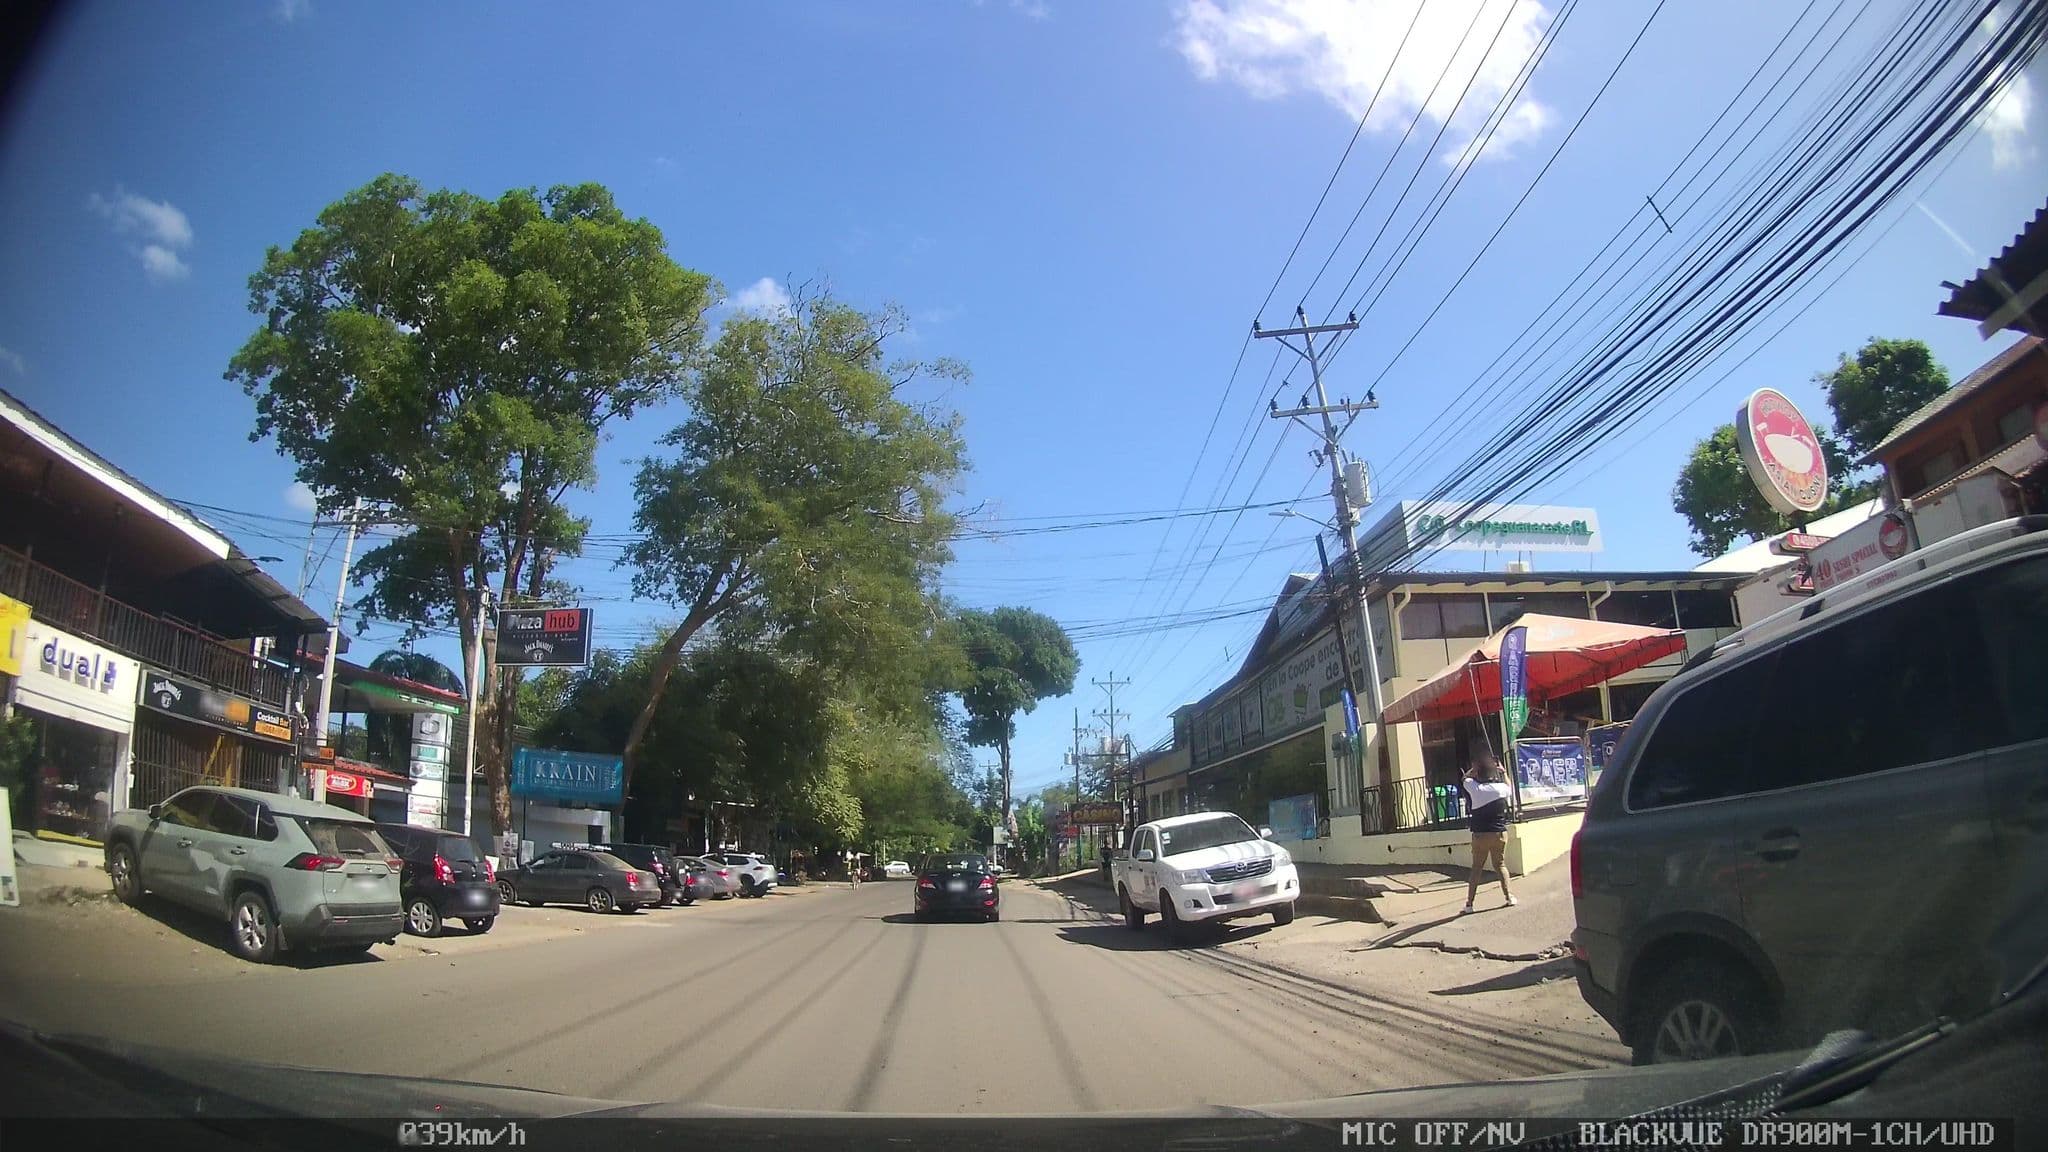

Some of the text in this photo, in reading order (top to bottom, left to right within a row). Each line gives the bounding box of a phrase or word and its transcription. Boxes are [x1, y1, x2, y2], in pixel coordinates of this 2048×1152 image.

[549, 611, 575, 628] hub
[43, 636, 101, 680] dual
[257, 711, 279, 725] Cocktail
[534, 760, 597, 782] KRAIN
